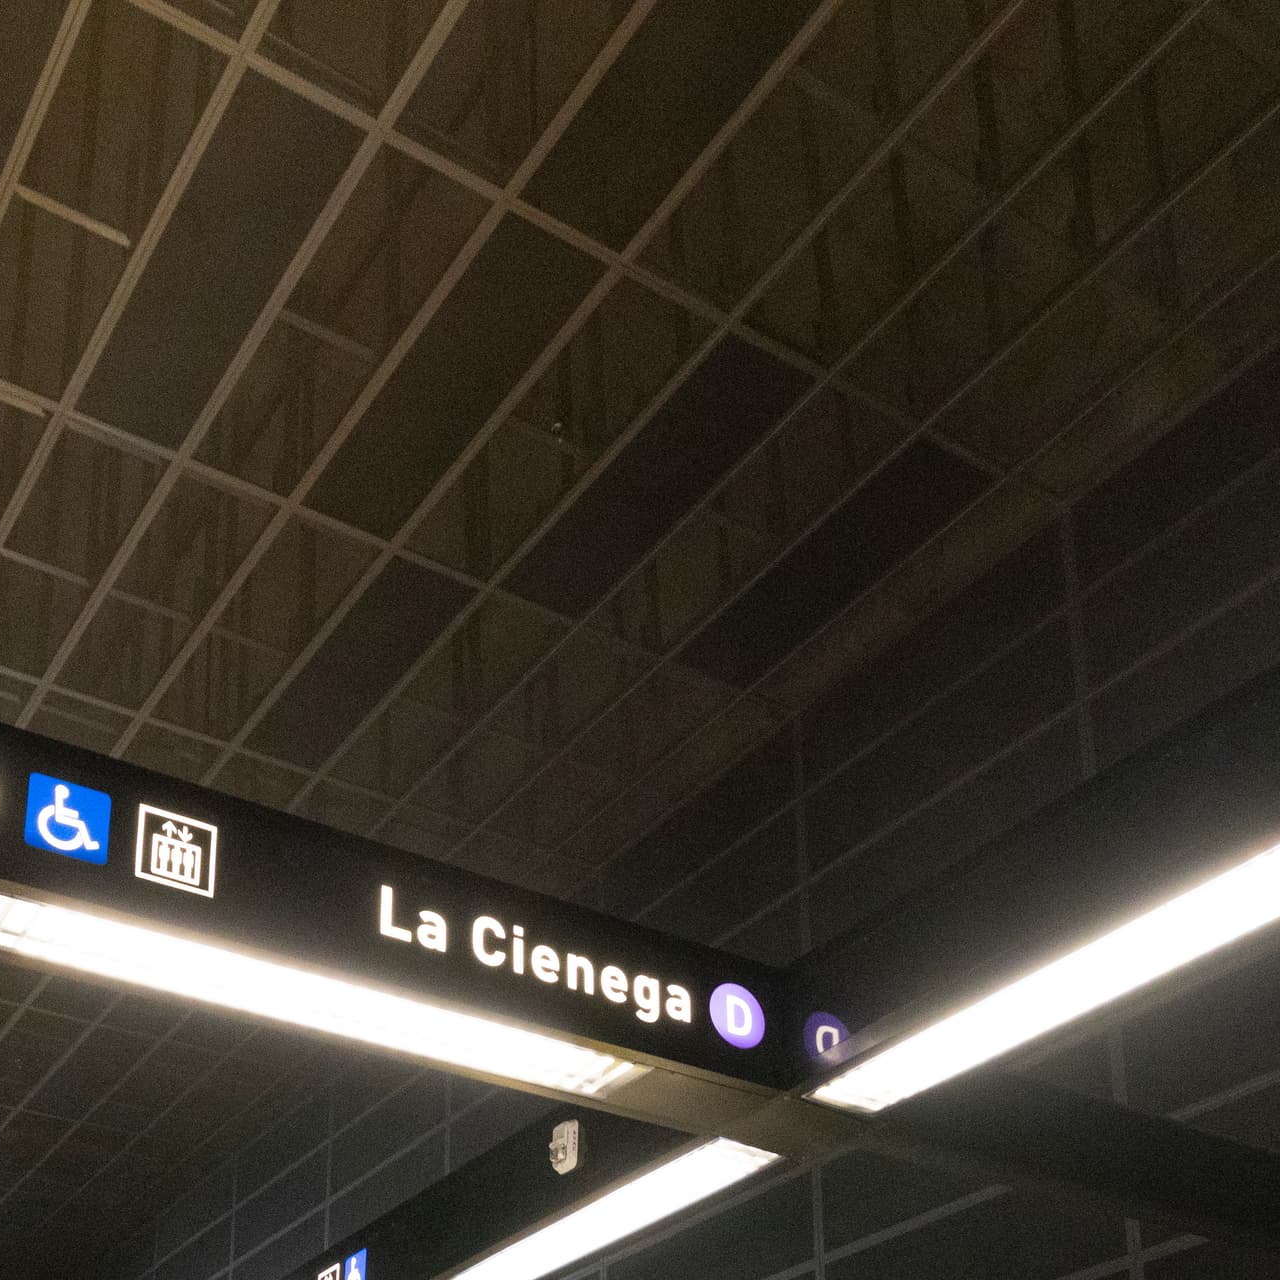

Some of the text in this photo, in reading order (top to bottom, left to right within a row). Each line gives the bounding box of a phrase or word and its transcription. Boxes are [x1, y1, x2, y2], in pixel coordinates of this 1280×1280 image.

[379, 884, 753, 1037] La Cienega D
